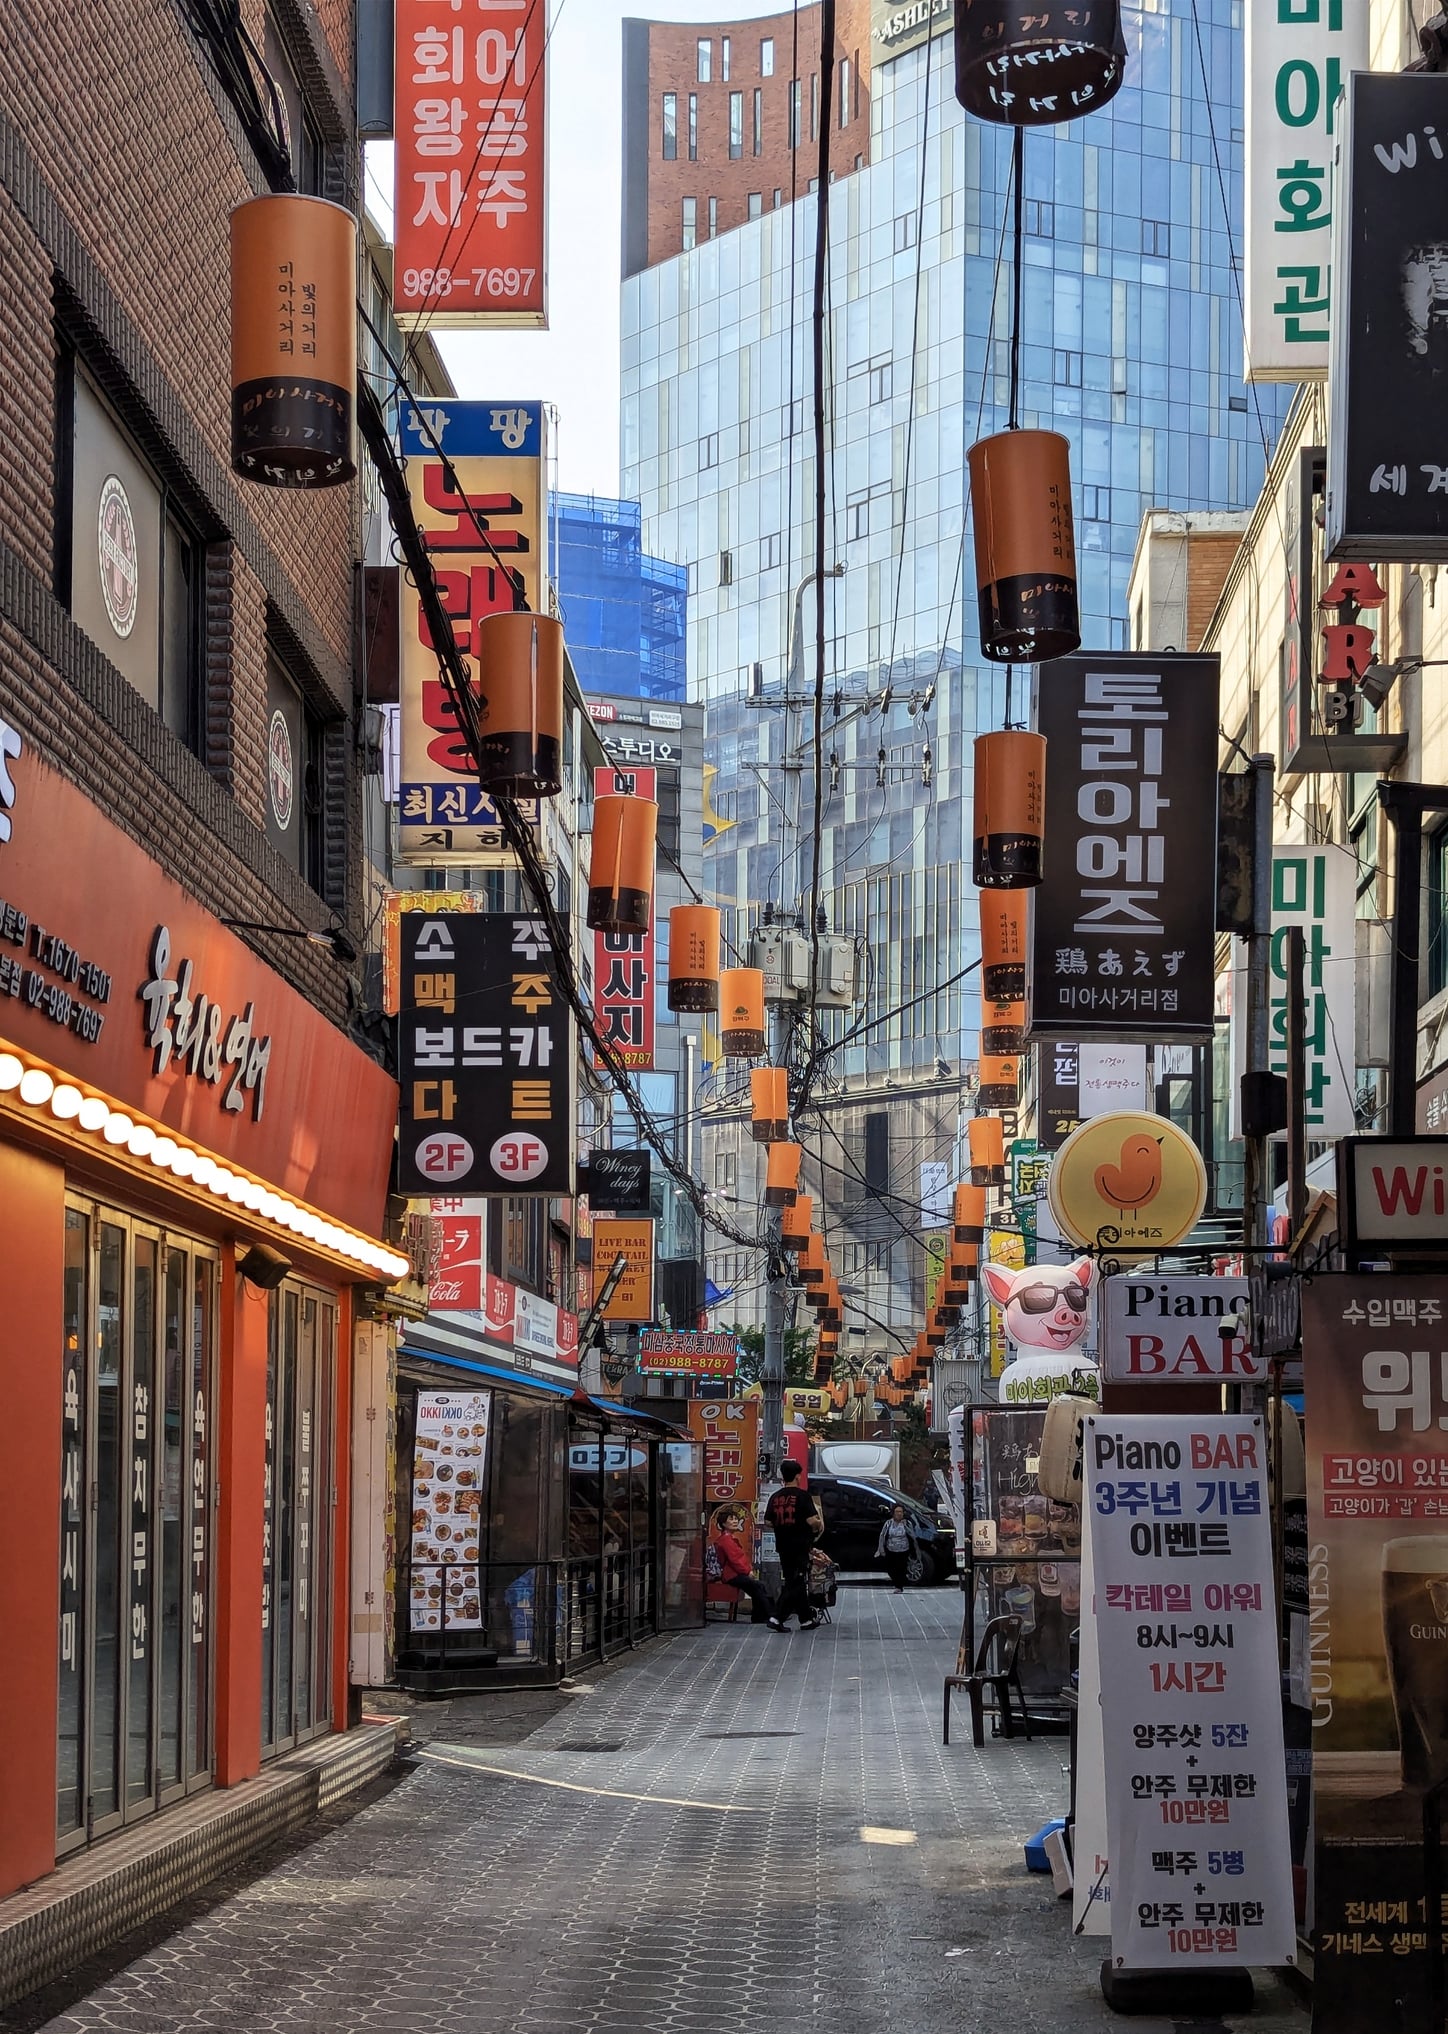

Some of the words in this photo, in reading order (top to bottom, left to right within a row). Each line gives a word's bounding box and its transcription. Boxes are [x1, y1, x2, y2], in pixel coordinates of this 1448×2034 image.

[412, 0, 468, 229] 회왕자
[475, 0, 528, 229] 어공주
[403, 267, 536, 297] 988-7697
[277, 260, 296, 357] 미아사거리
[300, 284, 317, 359] 빛의거리
[1074, 672, 1171, 935] 토리아에즈
[37, 925, 113, 1004] T.1670-1501
[28, 970, 105, 1045] 02-988-7697
[414, 973, 553, 1014] 맥주
[1058, 987, 1180, 1012] 미아사거리점
[143, 924, 272, 1123] 육회&연어
[414, 1026, 554, 1067] 보드카
[413, 1079, 553, 1121] 다트
[424, 1143, 466, 1172] 2F
[499, 1142, 541, 1171] 3F
[596, 1154, 643, 1179] Winey
[609, 1175, 640, 1194] days
[596, 1251, 649, 1260] COCTAIL
[599, 1238, 623, 1247] LIVE
[625, 1238, 646, 1247] BAR
[1124, 1284, 1250, 1318] Piano
[1341, 1298, 1443, 1328] 수입맥주
[649, 1356, 729, 1369] (02)988-8787
[1125, 1334, 1260, 1375] BAR
[699, 1403, 746, 1421] OK
[704, 1421, 744, 1500] 노래방
[1094, 1433, 1181, 1470] Piano
[1190, 1433, 1259, 1470] BAR
[1330, 1458, 1403, 1486] 고양이
[1095, 1480, 1182, 1516] 3주년
[1195, 1480, 1261, 1516] 기념
[1329, 1498, 1391, 1515] 고양이가
[61, 1367, 79, 1672] 육사시미
[131, 1381, 149, 1661] 참치무한
[192, 1389, 206, 1644] 육연무한
[1130, 1522, 1232, 1557] 이벤트
[1203, 1583, 1263, 1612] 아워
[1136, 1624, 1234, 1649] 8시~9시
[1307, 1543, 1334, 1728] GUINNESS
[1149, 1661, 1227, 1693] 1시간
[1132, 1723, 1202, 1749] 양주샷
[1211, 1723, 1249, 1748] 5잔
[1131, 1774, 1177, 1799] 안주
[1186, 1773, 1257, 1799] 무제한
[1159, 1800, 1230, 1825] 10만원
[1151, 1851, 1198, 1876] 맥주
[1208, 1850, 1245, 1876] 5병
[1137, 1902, 1185, 1928] 안주
[1195, 1901, 1265, 1927] 무제한
[1344, 1900, 1409, 1925] 전세계
[1167, 1928, 1238, 1953] 10만원
[1321, 1932, 1385, 1956] 기네스
